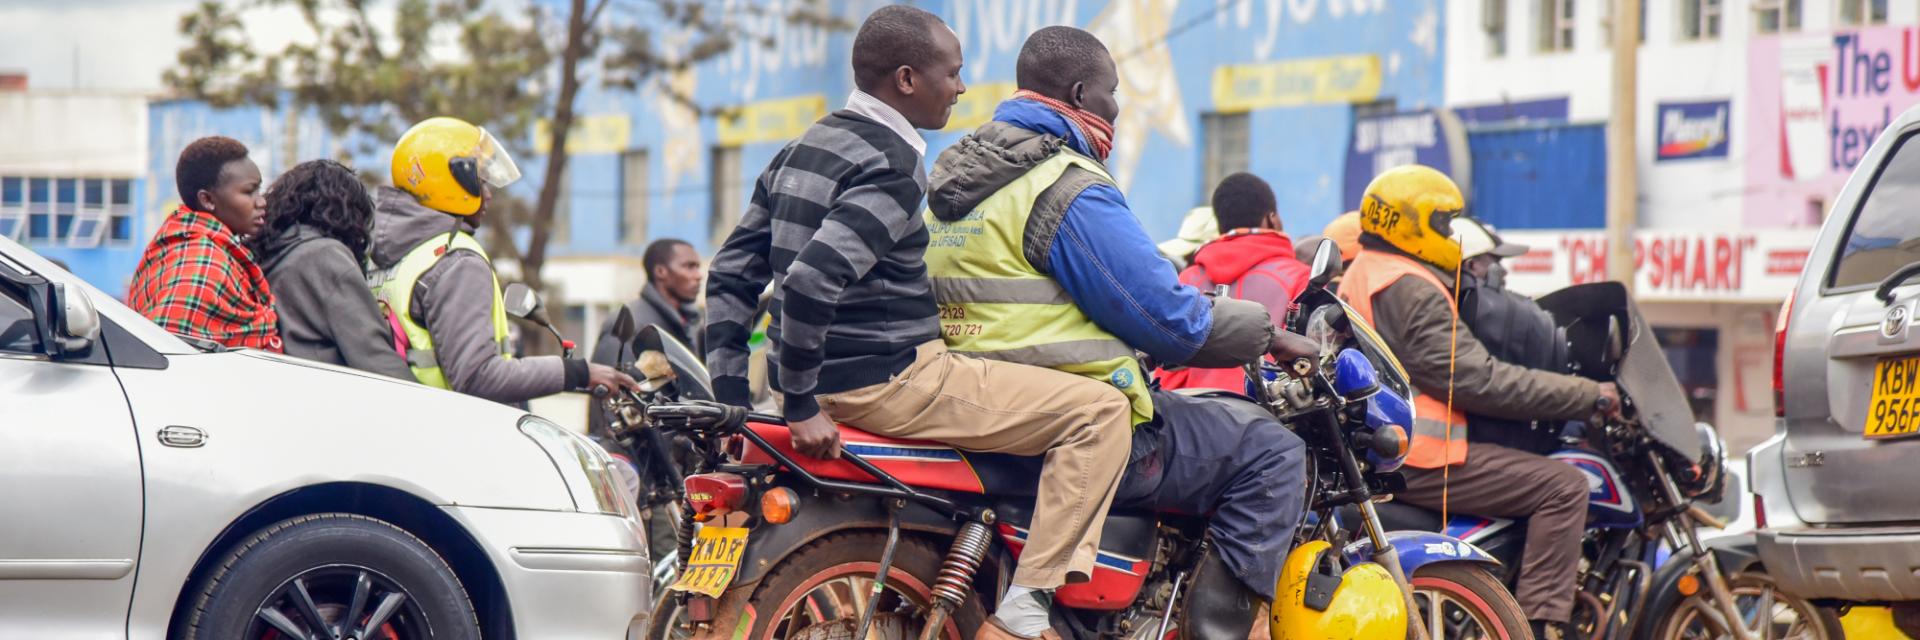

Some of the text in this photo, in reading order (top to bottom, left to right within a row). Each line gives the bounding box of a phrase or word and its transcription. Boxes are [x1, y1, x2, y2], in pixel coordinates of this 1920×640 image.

[1834, 33, 1890, 95] The
[937, 306, 965, 319] 2129
[944, 324, 982, 336] 720 721
[1879, 359, 1919, 395] KBW
